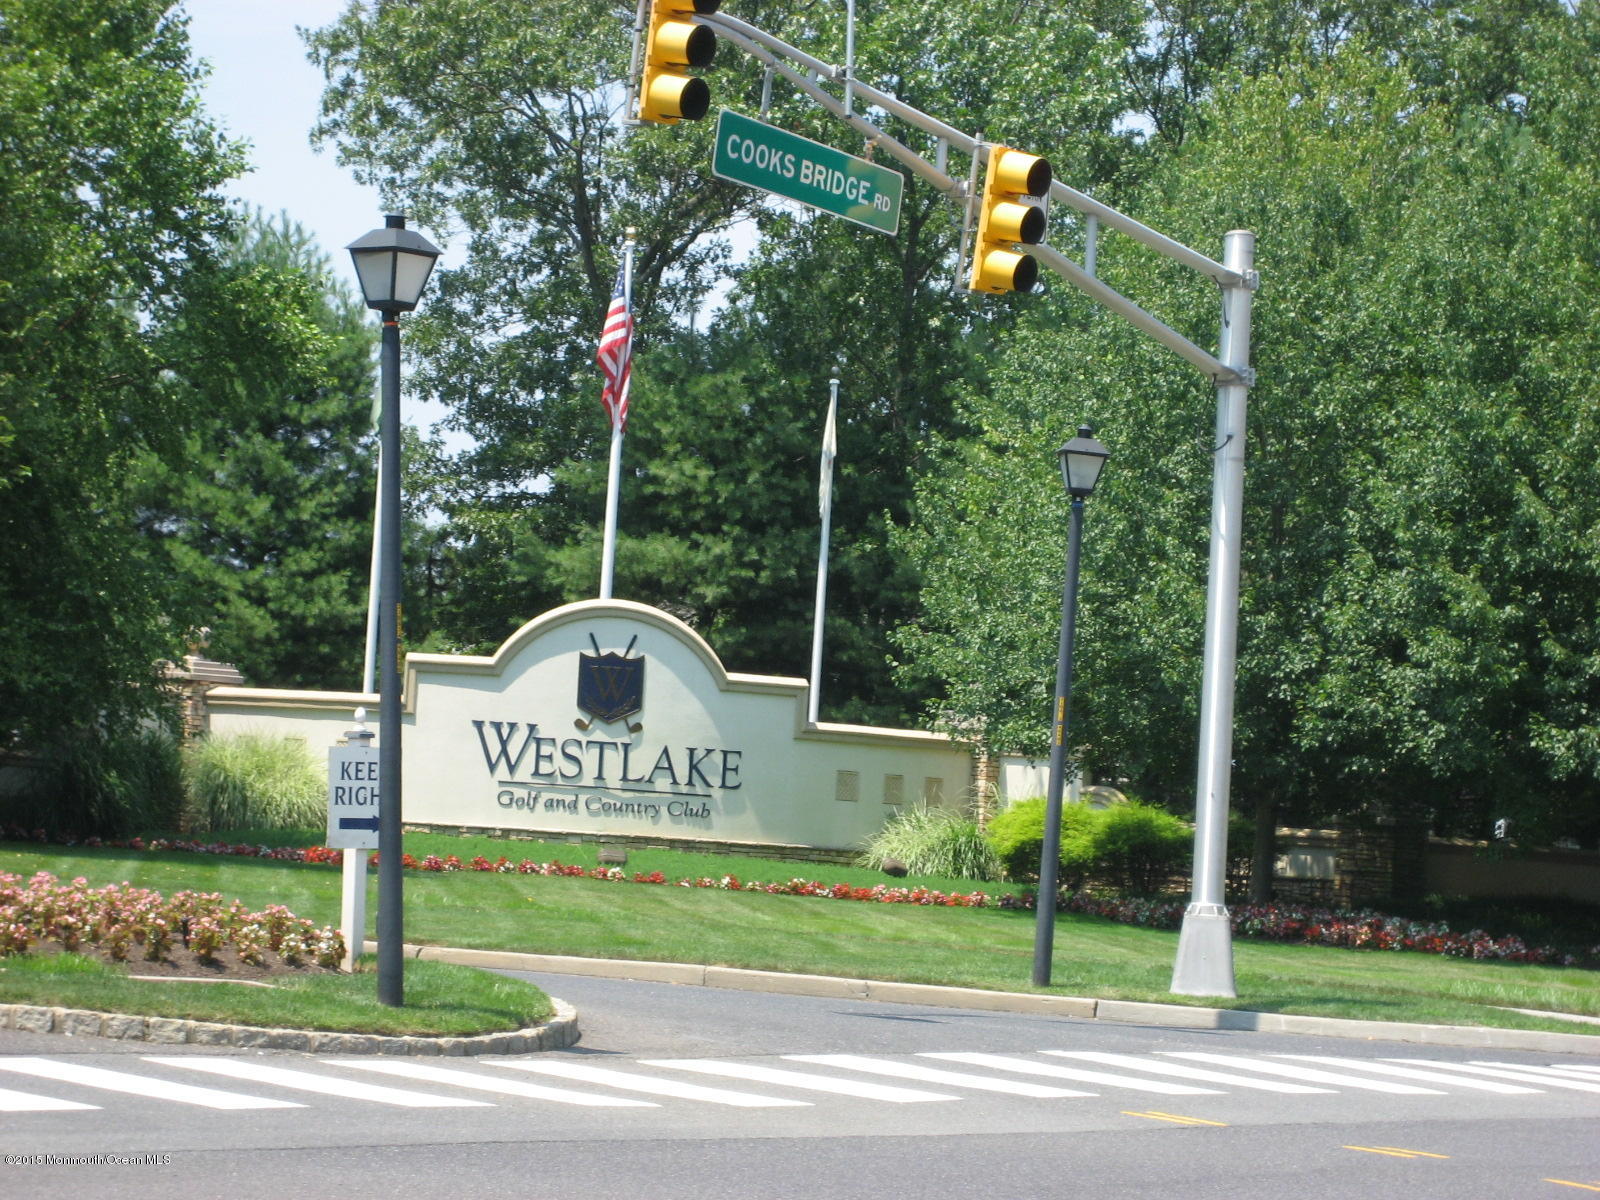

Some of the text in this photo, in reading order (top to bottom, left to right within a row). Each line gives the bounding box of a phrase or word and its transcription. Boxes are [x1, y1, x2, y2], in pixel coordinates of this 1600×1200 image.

[726, 134, 891, 212] COOKS BRIDGE RD
[590, 665, 635, 701] W
[341, 761, 378, 781] KEE
[471, 720, 742, 790] WESTLAKE
[334, 786, 380, 806] RIGH
[497, 790, 711, 818] Golf and Country Club
